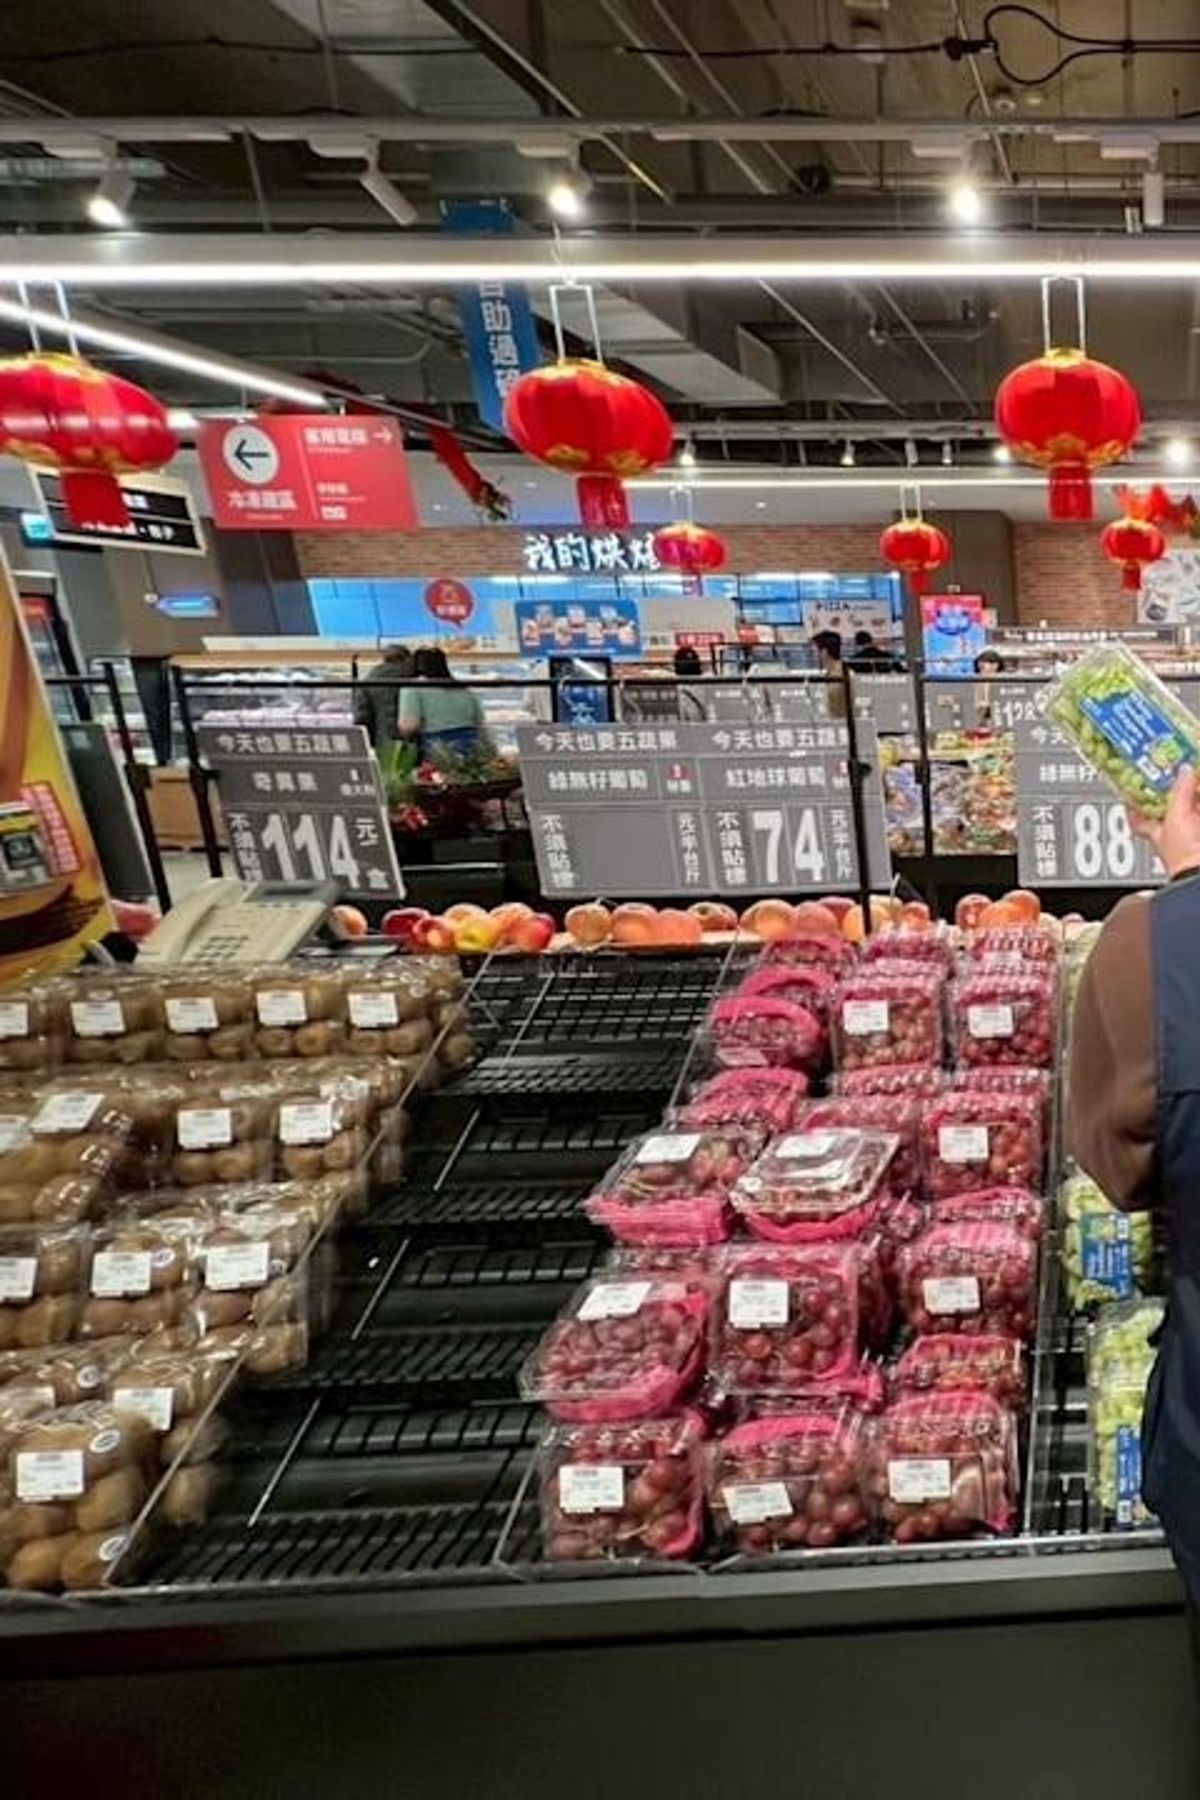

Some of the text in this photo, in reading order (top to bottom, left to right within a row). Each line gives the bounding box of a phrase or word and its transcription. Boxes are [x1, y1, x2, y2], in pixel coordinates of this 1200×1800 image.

[216, 733, 350, 753] 今天也要五蔬果
[535, 730, 678, 750] 今天也要五蔬果
[262, 814, 360, 888] 114
[753, 809, 824, 883] 74
[1074, 804, 1134, 878] 88
